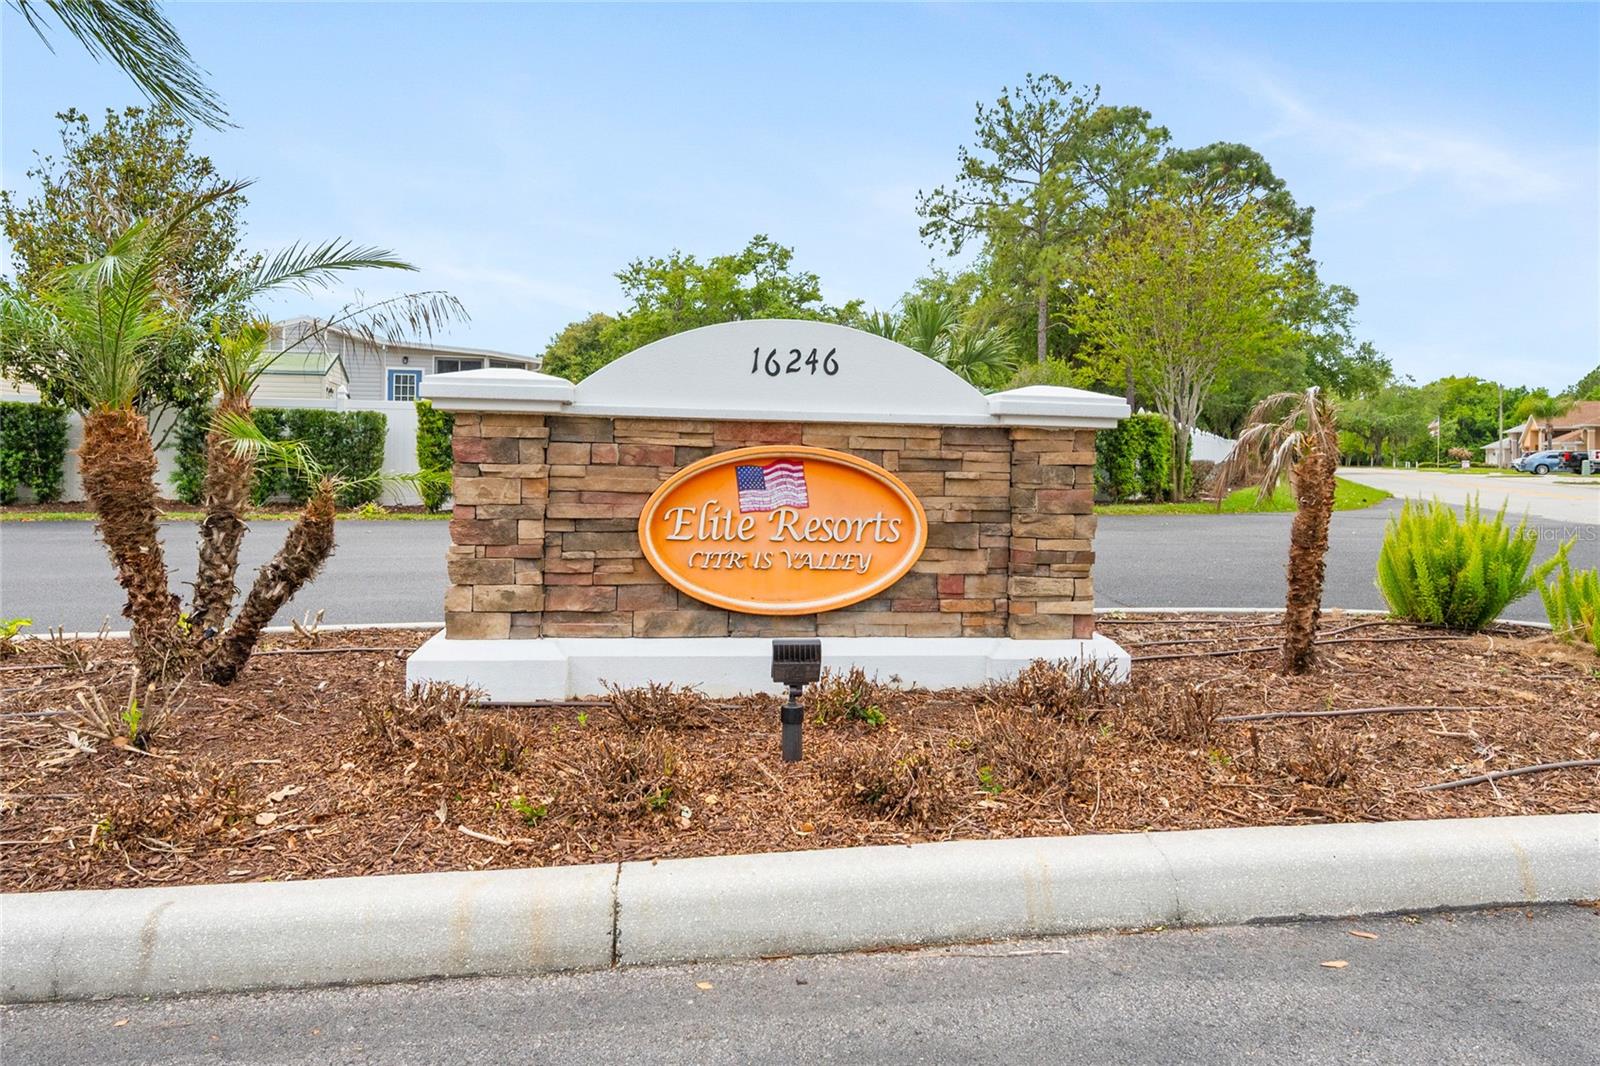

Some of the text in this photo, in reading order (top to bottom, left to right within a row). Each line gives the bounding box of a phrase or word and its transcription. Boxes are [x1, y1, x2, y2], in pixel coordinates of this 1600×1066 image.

[751, 347, 839, 377] 16246
[664, 499, 902, 543] Elite Resorts
[780, 548, 872, 574] VALLEY
